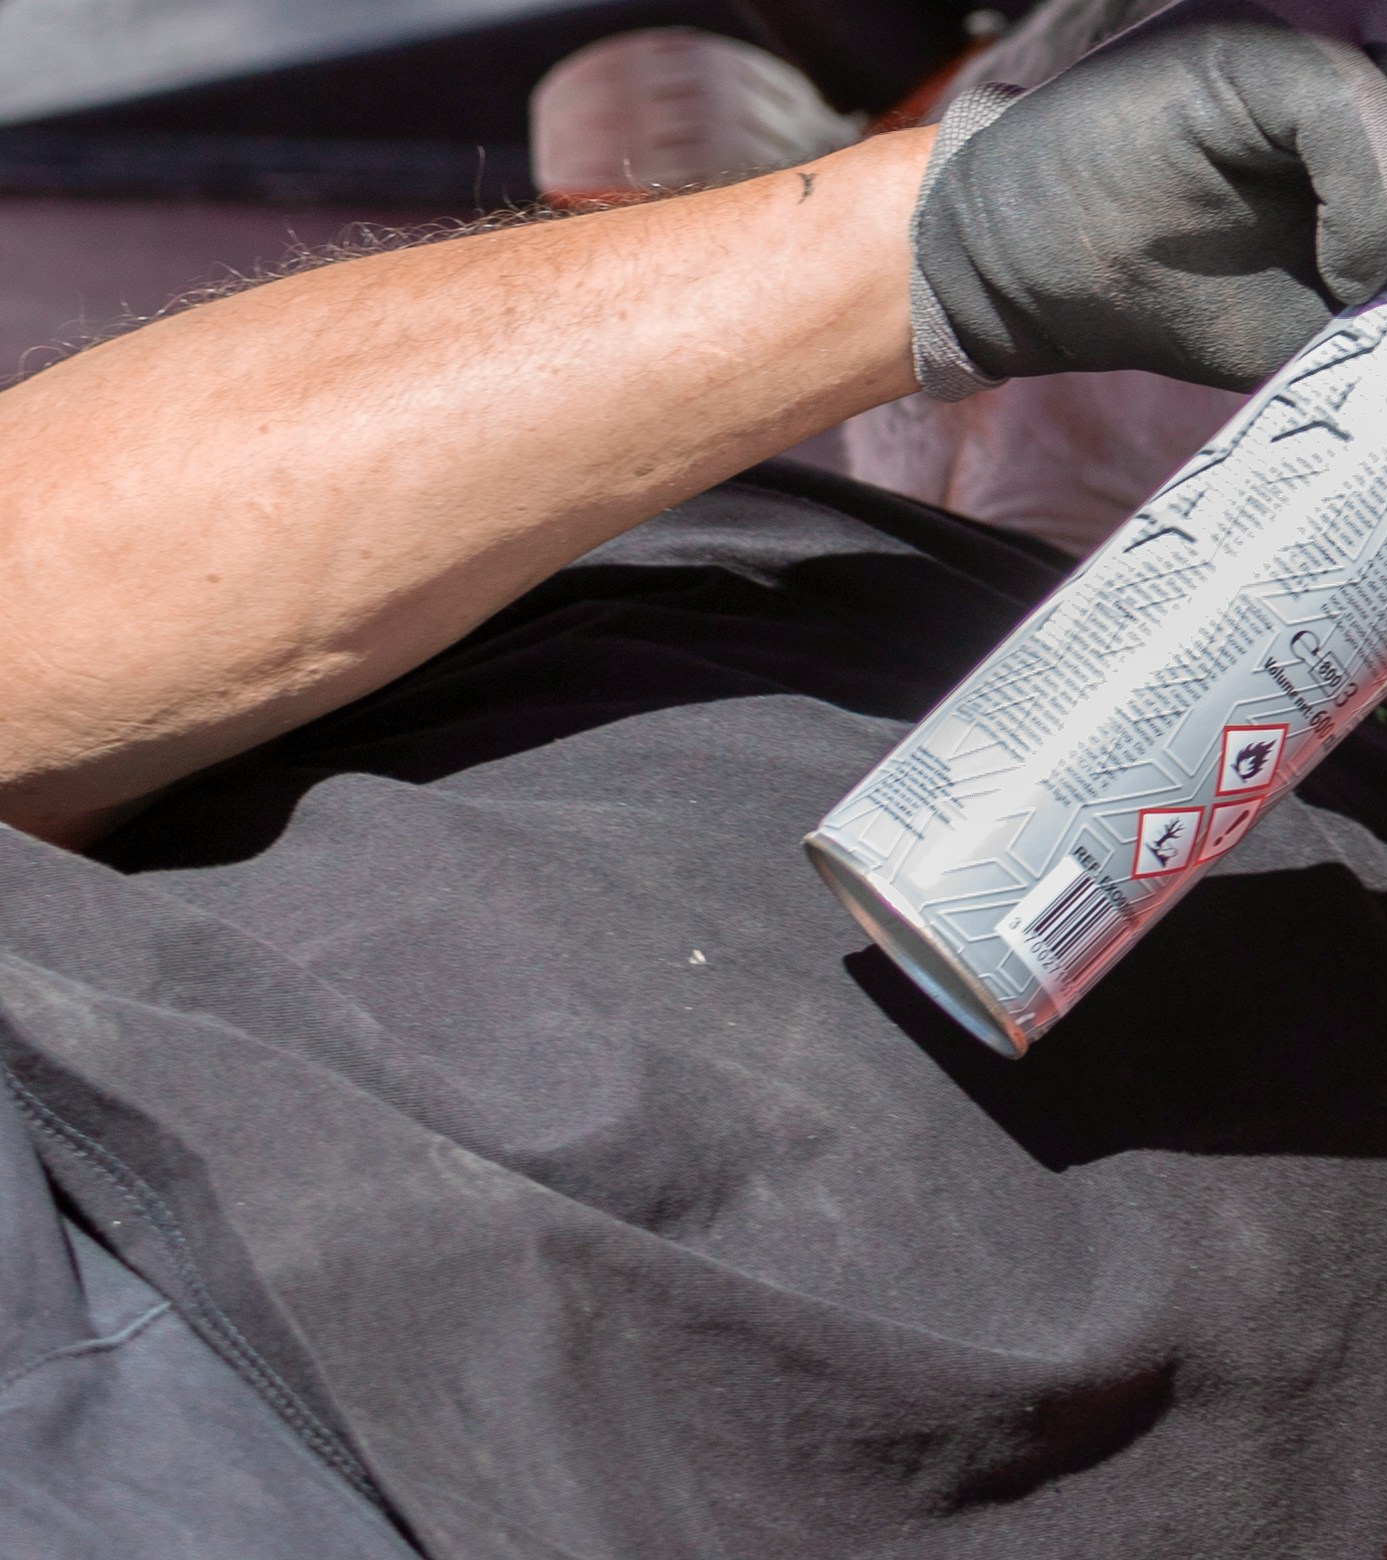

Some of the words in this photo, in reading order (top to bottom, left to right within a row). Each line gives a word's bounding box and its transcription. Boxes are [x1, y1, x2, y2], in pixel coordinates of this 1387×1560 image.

[1314, 658, 1345, 689] 800
[1259, 655, 1303, 701] Volume
[1304, 708, 1338, 741] 600
[1006, 914, 1024, 932] 3
